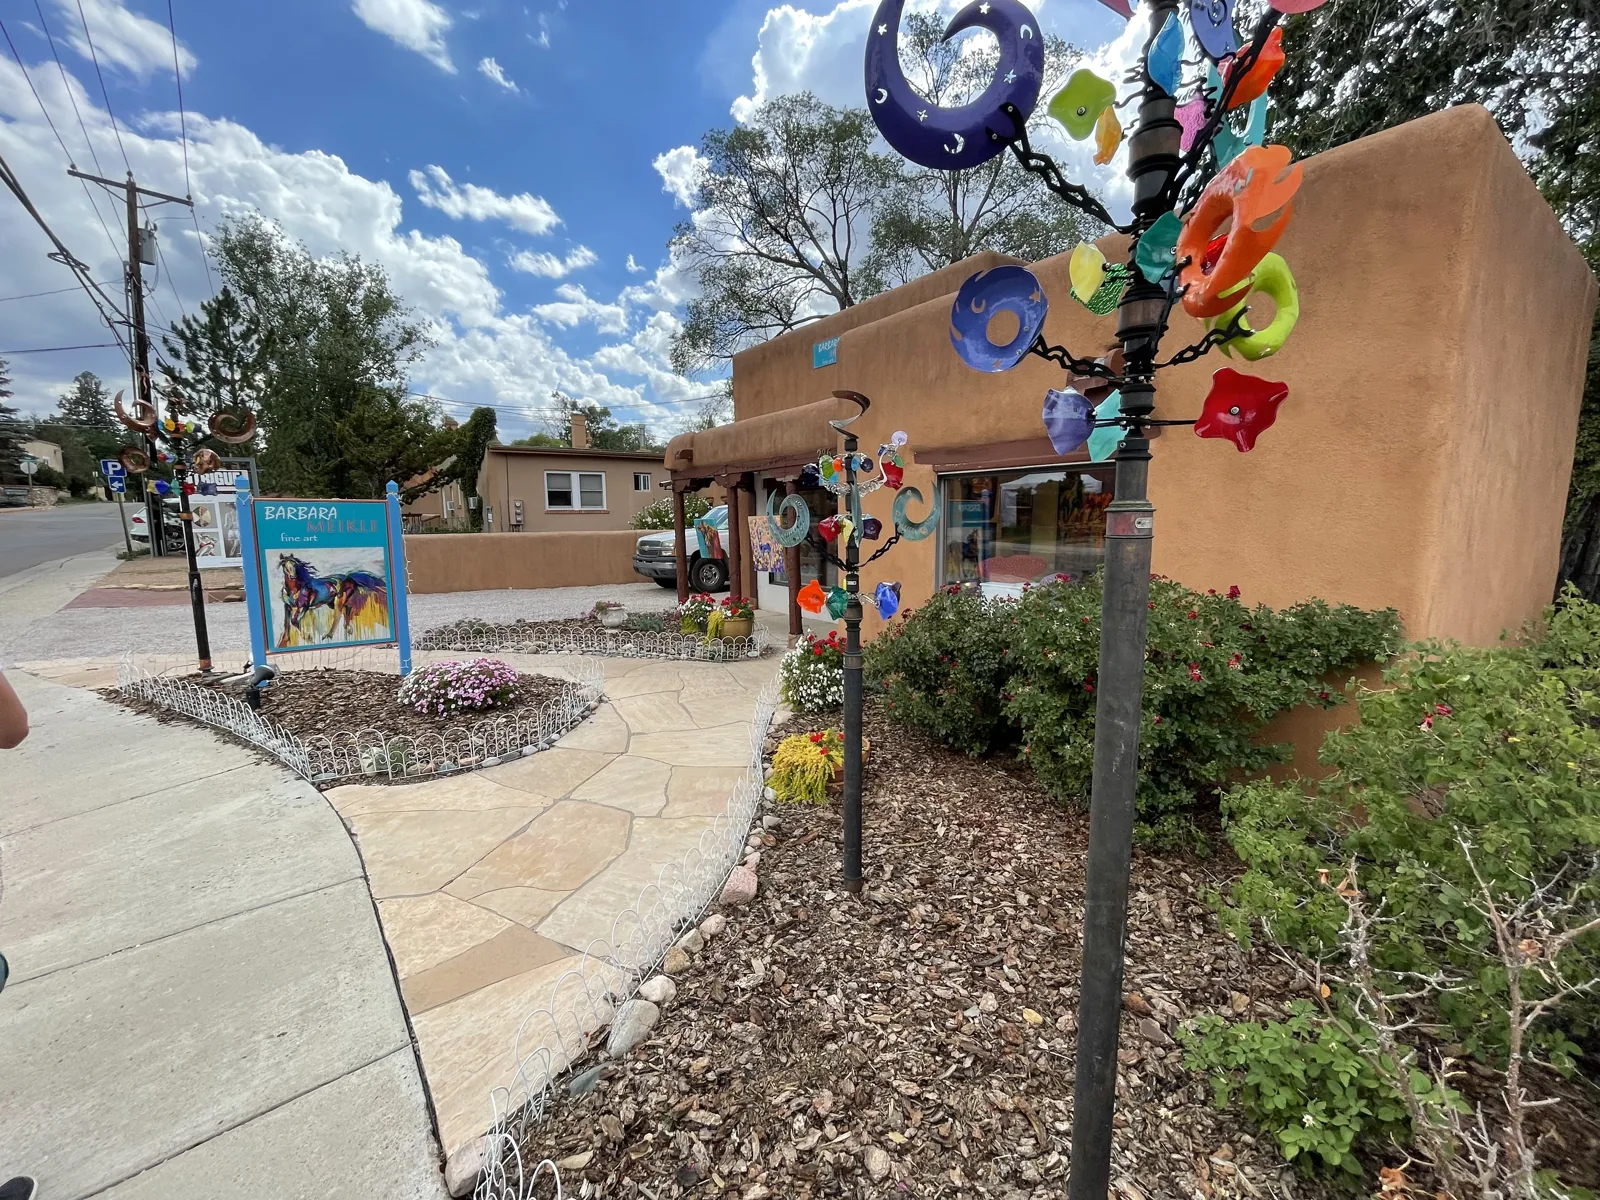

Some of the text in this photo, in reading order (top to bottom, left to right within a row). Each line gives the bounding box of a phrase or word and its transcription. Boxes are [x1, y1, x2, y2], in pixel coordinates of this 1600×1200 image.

[107, 461, 122, 475] P
[264, 506, 337, 520] BARBARA
[306, 519, 378, 533] MEIKLE
[280, 532, 300, 542] fine
